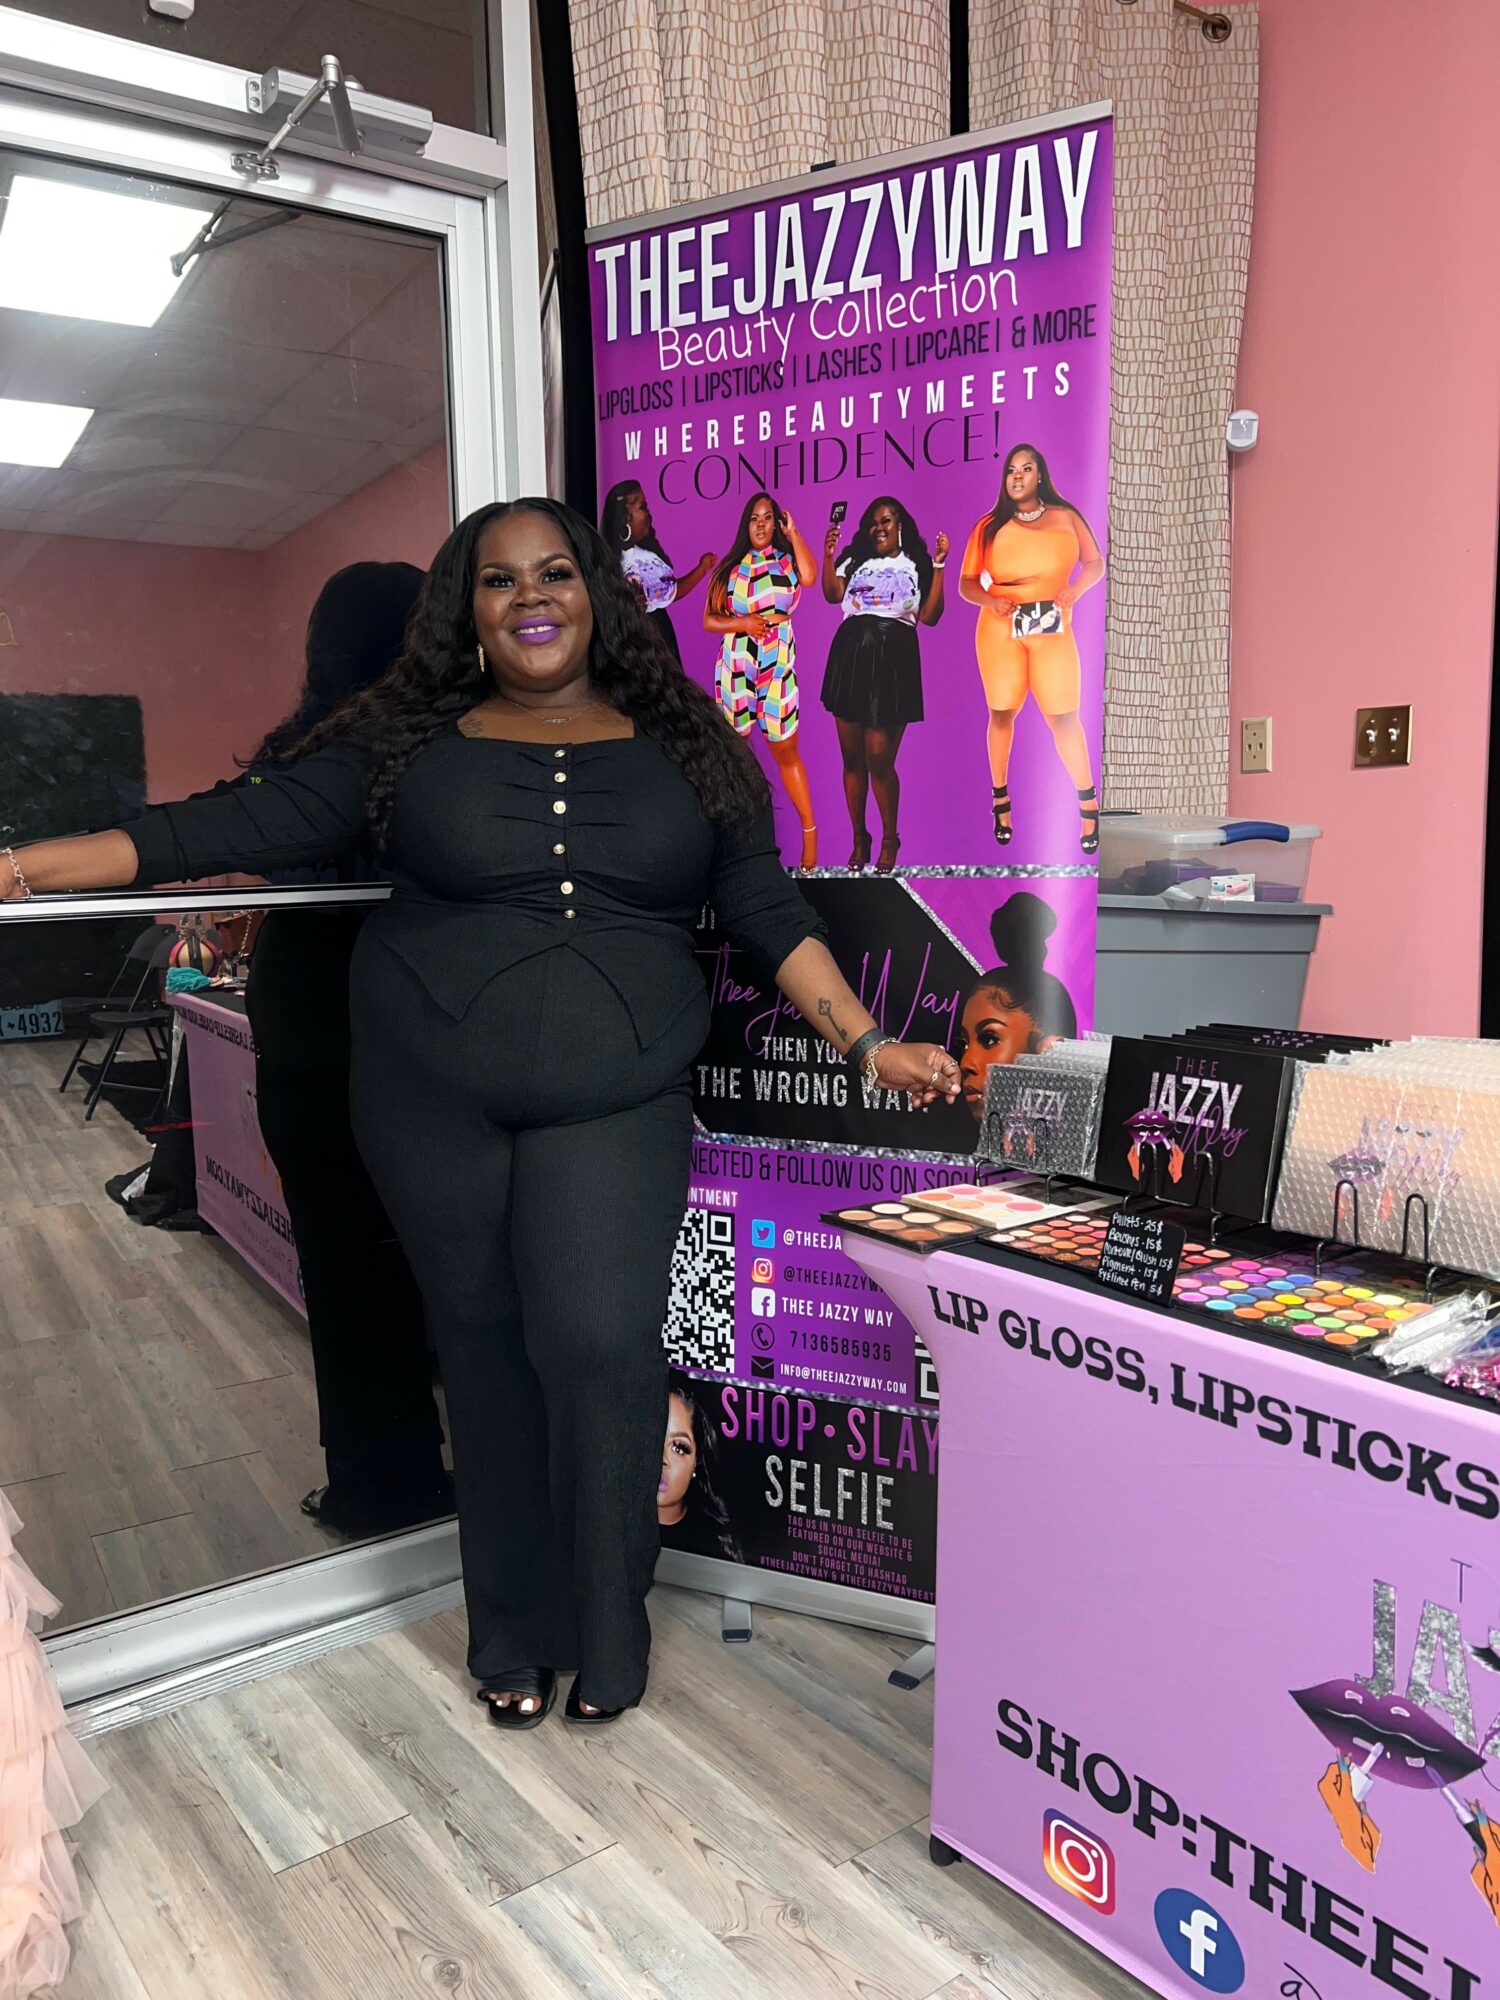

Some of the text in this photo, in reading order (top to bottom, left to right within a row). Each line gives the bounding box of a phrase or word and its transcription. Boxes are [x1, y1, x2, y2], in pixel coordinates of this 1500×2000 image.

[595, 130, 1098, 342] THEEJAZZYWAY
[658, 268, 1018, 375] Beauty Collection
[599, 303, 1097, 421] LIPGLOSS LIPSTICKS LASHES LIPCARE & MORE
[658, 411, 1001, 505] CONFIDENCE!
[694, 941, 761, 1011] Thee
[762, 1036, 807, 1062] THEN
[1175, 1056, 1219, 1078] THEE
[698, 1065, 741, 1100] THE
[753, 1069, 848, 1107] WRONG
[1143, 1072, 1243, 1131] JAZZY
[759, 1153, 771, 1181] &
[776, 1155, 852, 1189] FOLLOW
[859, 1162, 883, 1192] US
[890, 1166, 916, 1194] ON
[1144, 1220, 1164, 1236] 25$
[1145, 1237, 1162, 1252] 15$
[1143, 1267, 1158, 1282] 15$
[1159, 1258, 1173, 1271] 15$
[782, 1297, 813, 1316] THEE
[819, 1302, 859, 1322] JAZZY
[864, 1308, 893, 1328] WAY
[790, 1331, 891, 1361] 7136585935
[780, 1364, 907, 1395] INFO@THEEJAZZYWAY.COM
[721, 1386, 816, 1451] SHOP
[927, 1285, 1500, 1520] LIP GLOSS, LIPSTICKS
[765, 1455, 894, 1530] SELFIE
[787, 1515, 913, 1550] TAG US IN YOUR SELFIE TO BE
[787, 1527, 912, 1562] FEATURED ON OUR WEBSITE &
[760, 1556, 828, 1580] #THEEJAZZYWAY
[831, 1570, 837, 1581] &
[792, 1551, 907, 1585] DON'T FORGET TO HASHTAG
[818, 1545, 847, 1560] SOCIAL
